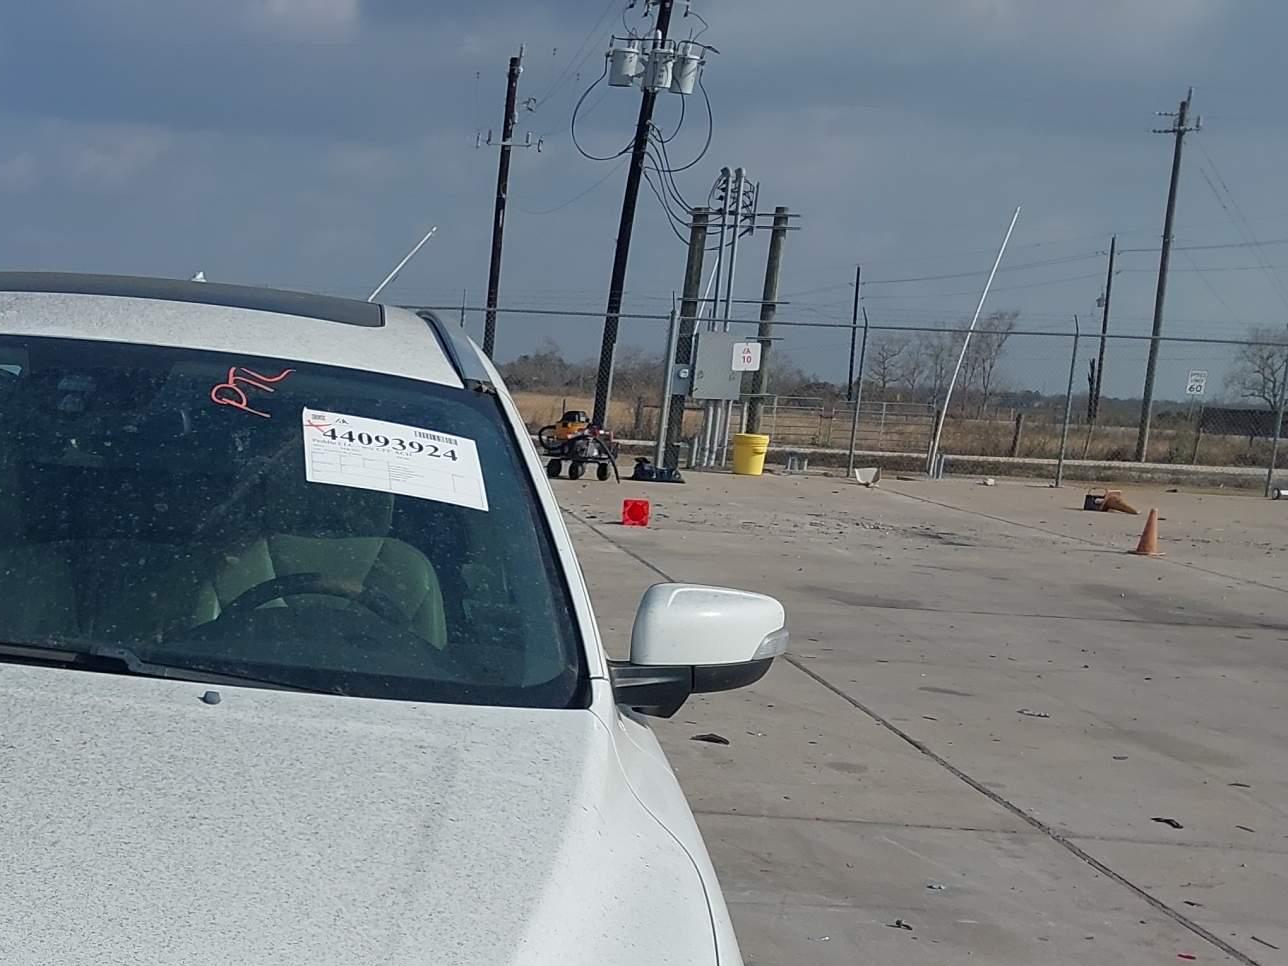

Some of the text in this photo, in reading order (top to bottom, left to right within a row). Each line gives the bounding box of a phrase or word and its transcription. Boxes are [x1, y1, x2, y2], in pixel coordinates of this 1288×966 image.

[742, 355, 752, 363] 10
[1188, 384, 1202, 392] 60
[322, 427, 459, 462] 44093924
